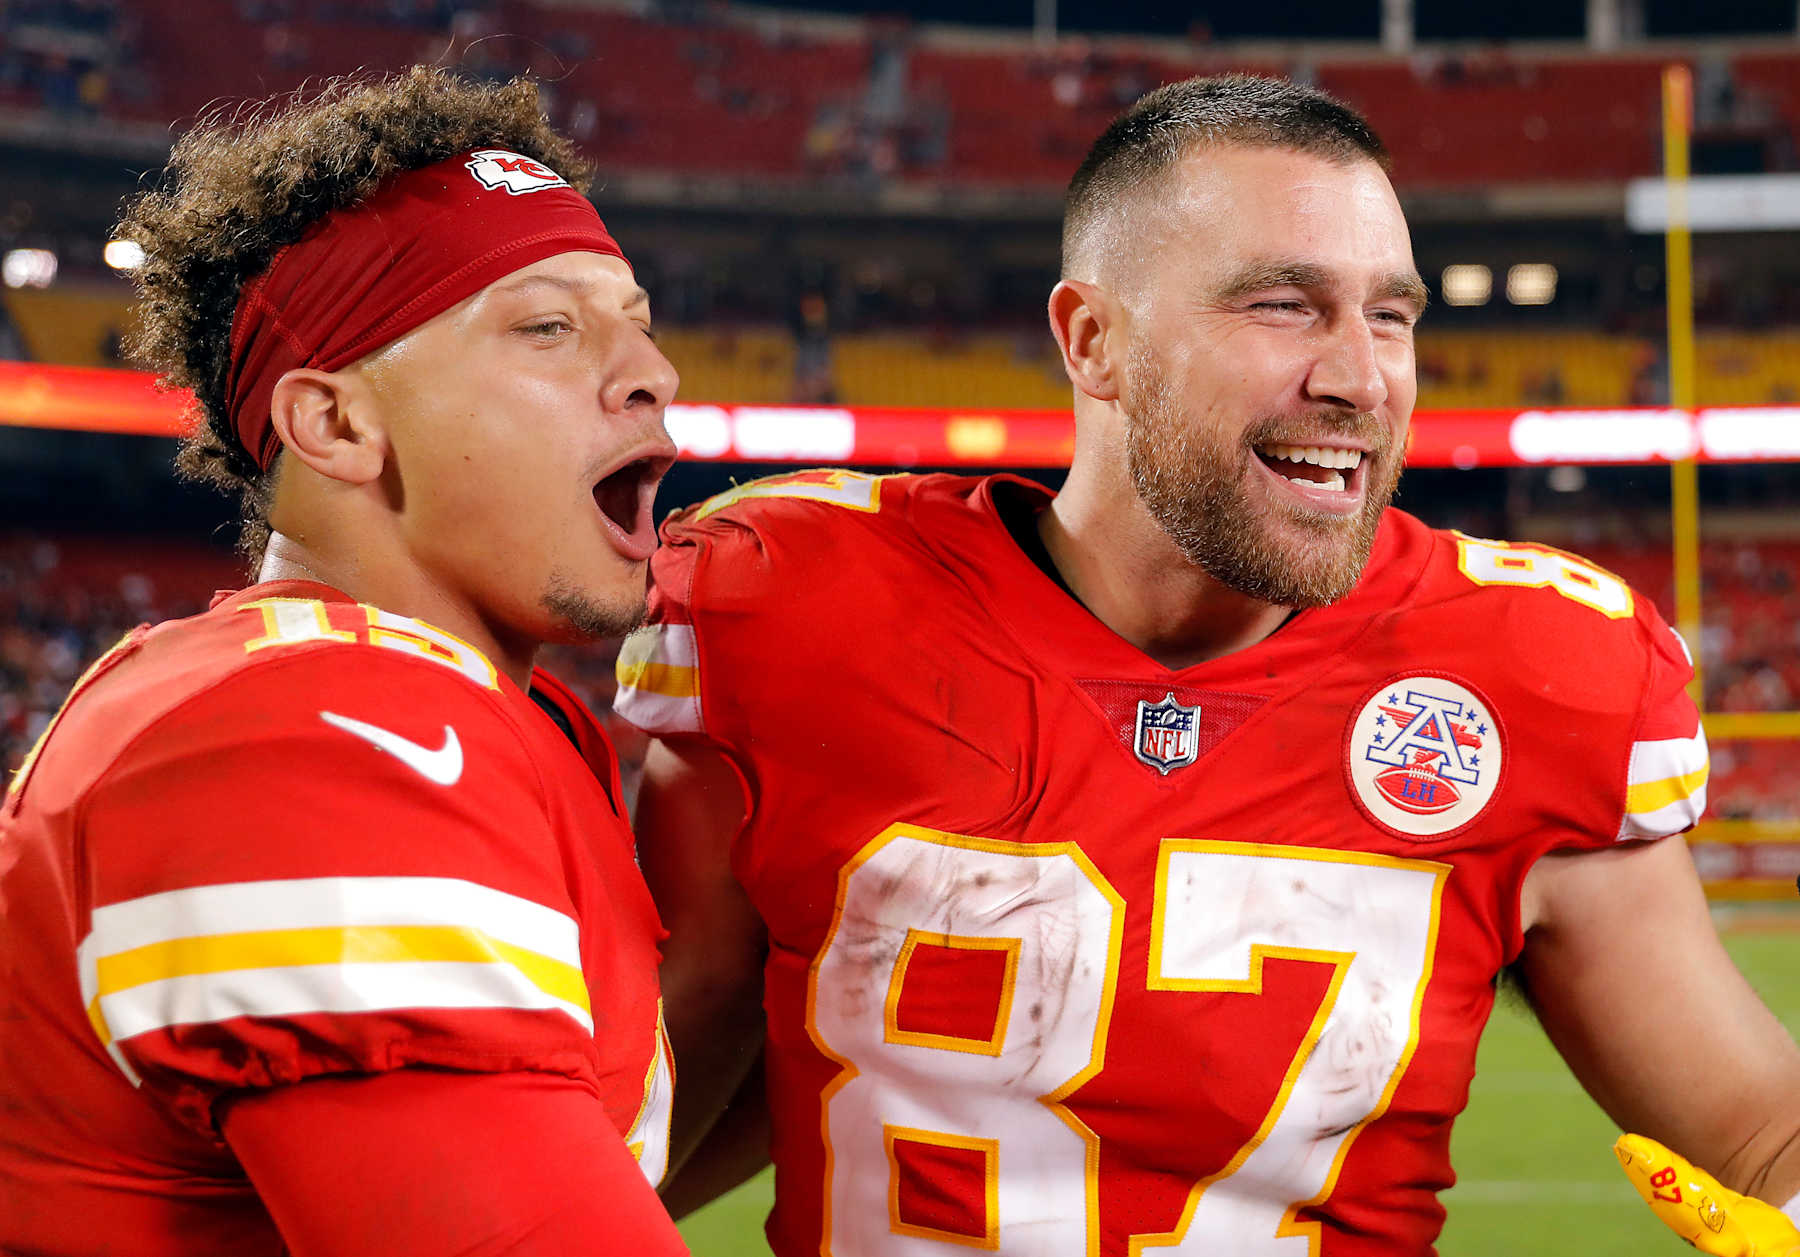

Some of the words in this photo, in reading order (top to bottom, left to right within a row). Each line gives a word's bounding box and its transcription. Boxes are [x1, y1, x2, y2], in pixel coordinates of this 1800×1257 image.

[491, 158, 559, 181] KC
[237, 597, 503, 694] 15
[1145, 729, 1186, 760] NFL
[1401, 778, 1438, 803] LH
[805, 821, 1454, 1257] 87
[1650, 1166, 1682, 1203] 87
